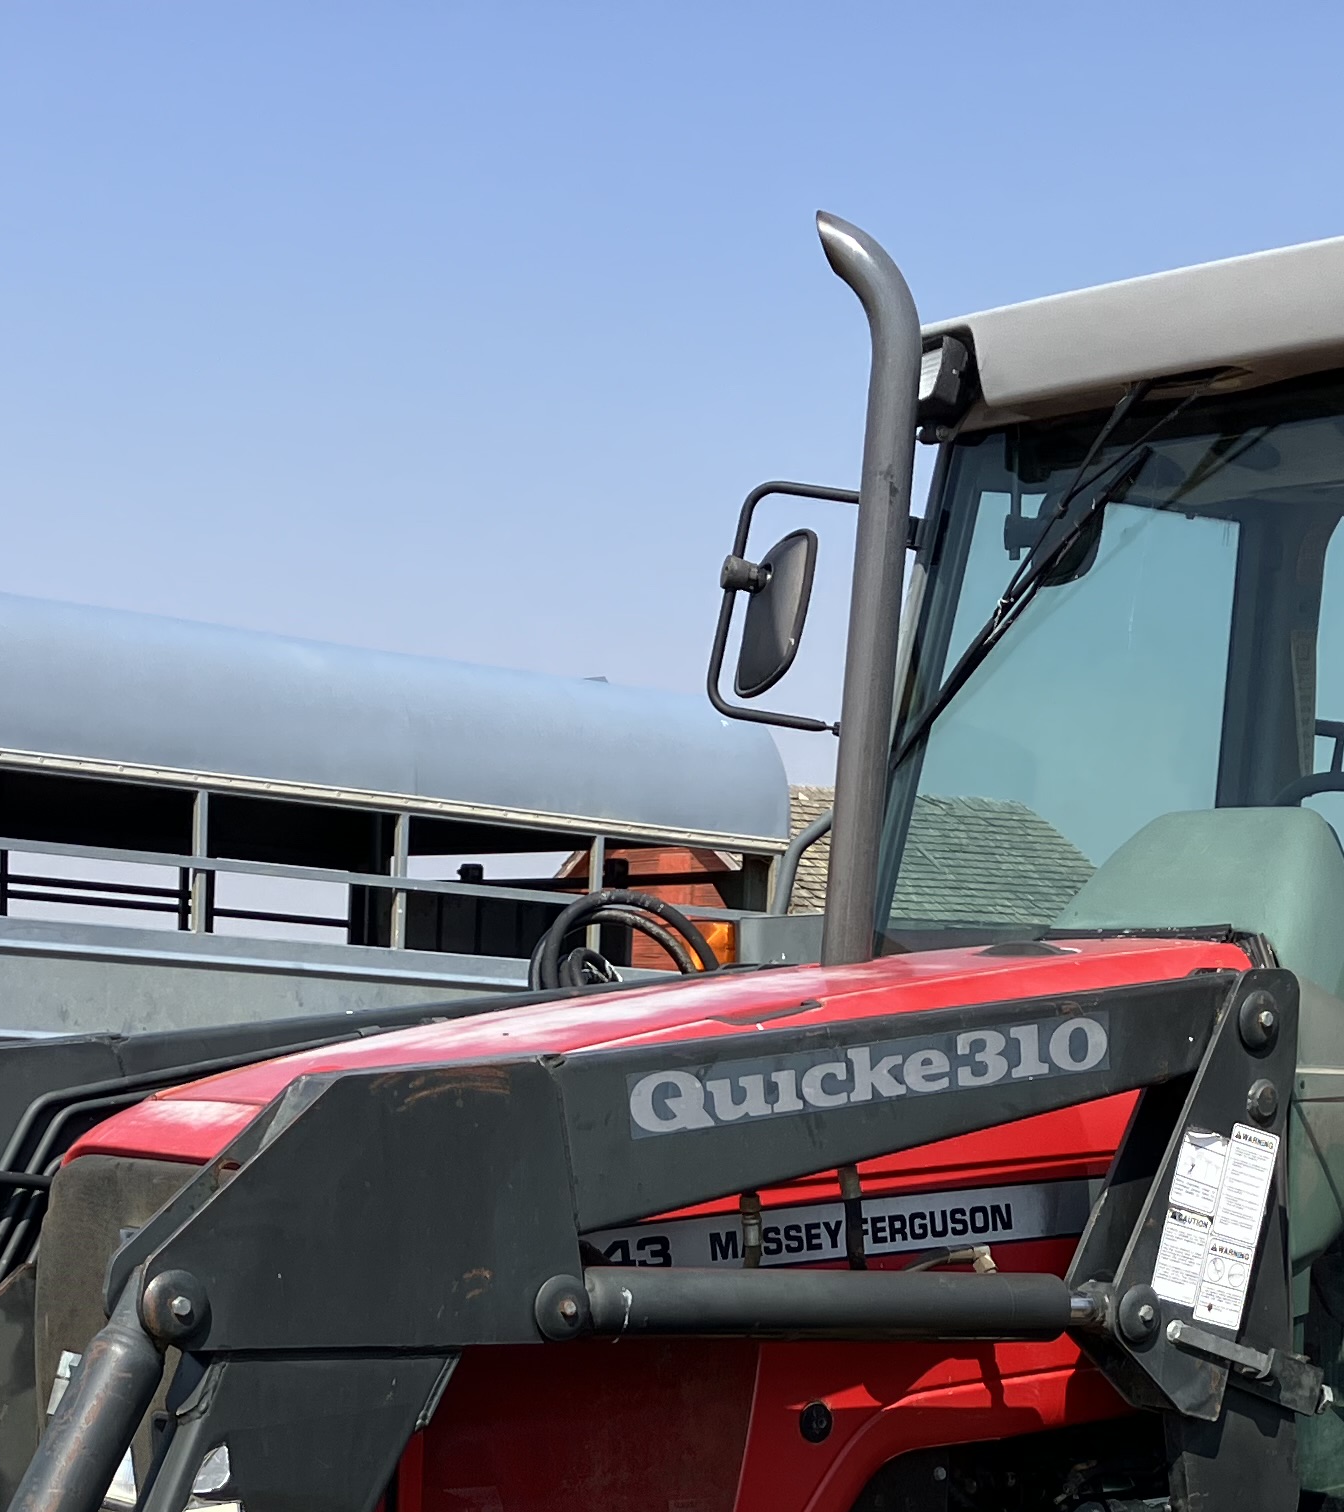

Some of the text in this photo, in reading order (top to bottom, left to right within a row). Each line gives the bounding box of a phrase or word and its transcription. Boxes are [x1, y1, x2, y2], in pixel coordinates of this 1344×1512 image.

[1242, 1132, 1274, 1150] WARNING
[709, 1220, 843, 1262] MSSEY
[1218, 1245, 1250, 1261] WARNING
